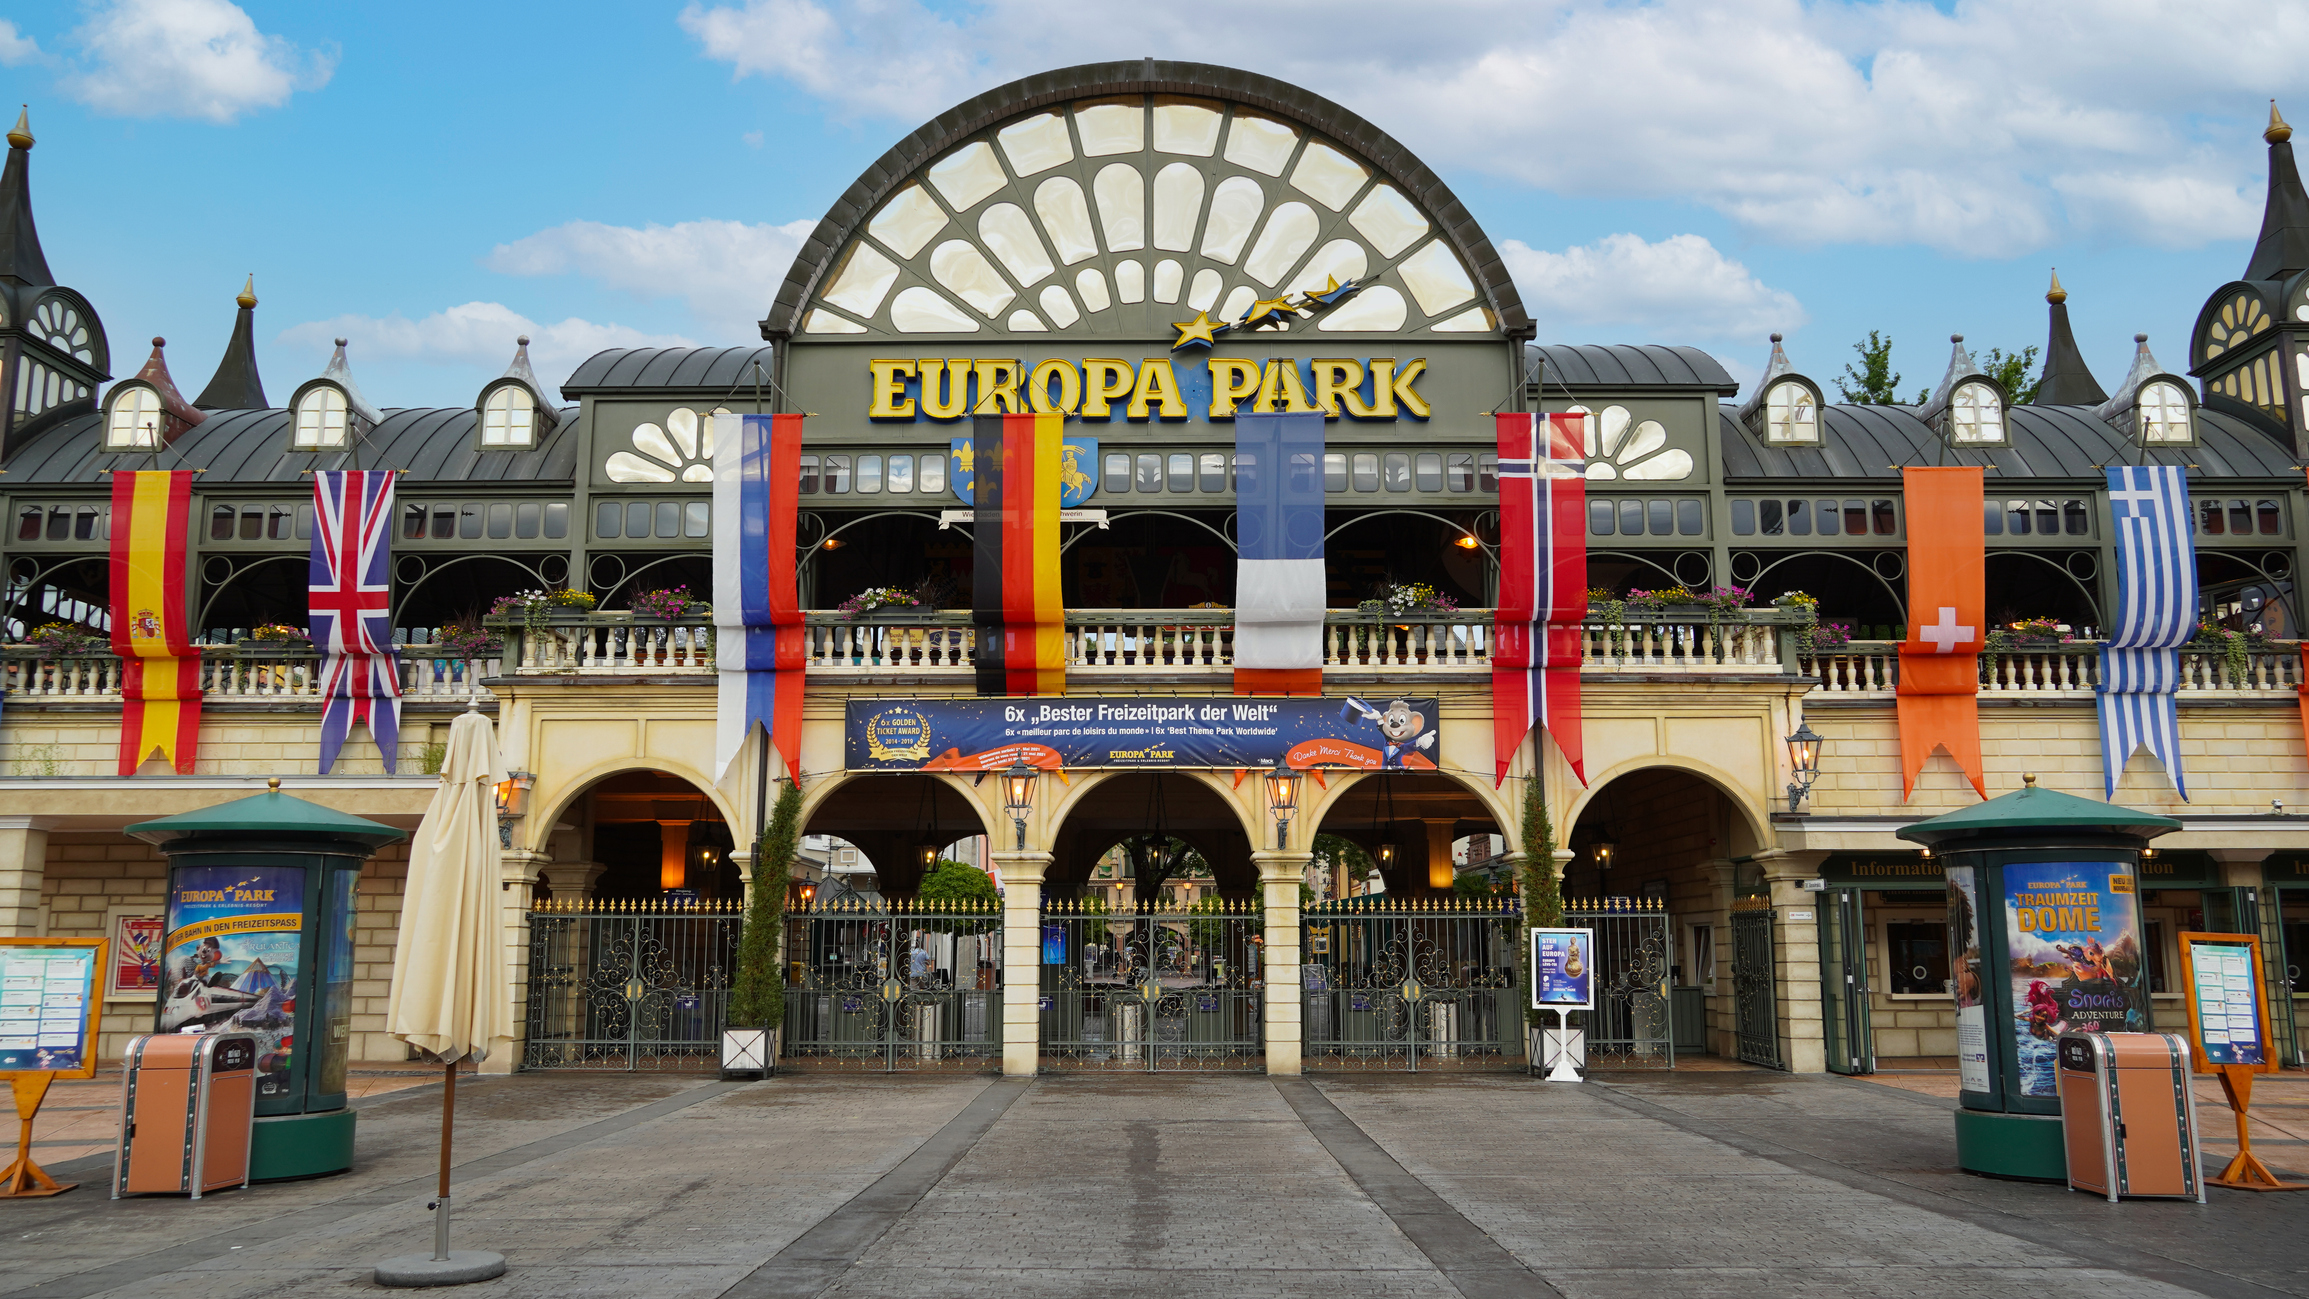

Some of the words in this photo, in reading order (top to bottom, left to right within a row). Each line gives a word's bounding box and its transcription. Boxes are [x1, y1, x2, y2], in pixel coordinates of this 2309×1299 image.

[869, 358, 1188, 423] EUROPA
[1208, 357, 1431, 423] PARK
[1004, 706, 1026, 722] 6x
[1031, 705, 1093, 724] „Bester
[1098, 704, 1195, 724] Freizeitpark
[1200, 704, 1227, 720] der
[1232, 704, 1278, 720] Welt“
[1054, 729, 1070, 737] parc
[1072, 728, 1081, 736] de
[1188, 727, 1214, 735] Theme
[1216, 727, 1234, 735] Park
[1293, 749, 1317, 762] Danke
[1320, 745, 1341, 756] Merci
[1344, 748, 1364, 762] Thank
[1851, 861, 1946, 876] Informatio
[180, 890, 225, 902] EUROPA
[234, 890, 274, 901] PARK
[2016, 893, 2098, 906] TRAUMZEIT
[2017, 907, 2101, 932] DOME
[184, 927, 202, 938] BAHN
[204, 925, 212, 933] IN
[214, 922, 230, 932] DEN
[232, 918, 297, 929] FREIZEITSPASS
[2071, 1011, 2124, 1020] ADVENTURE
